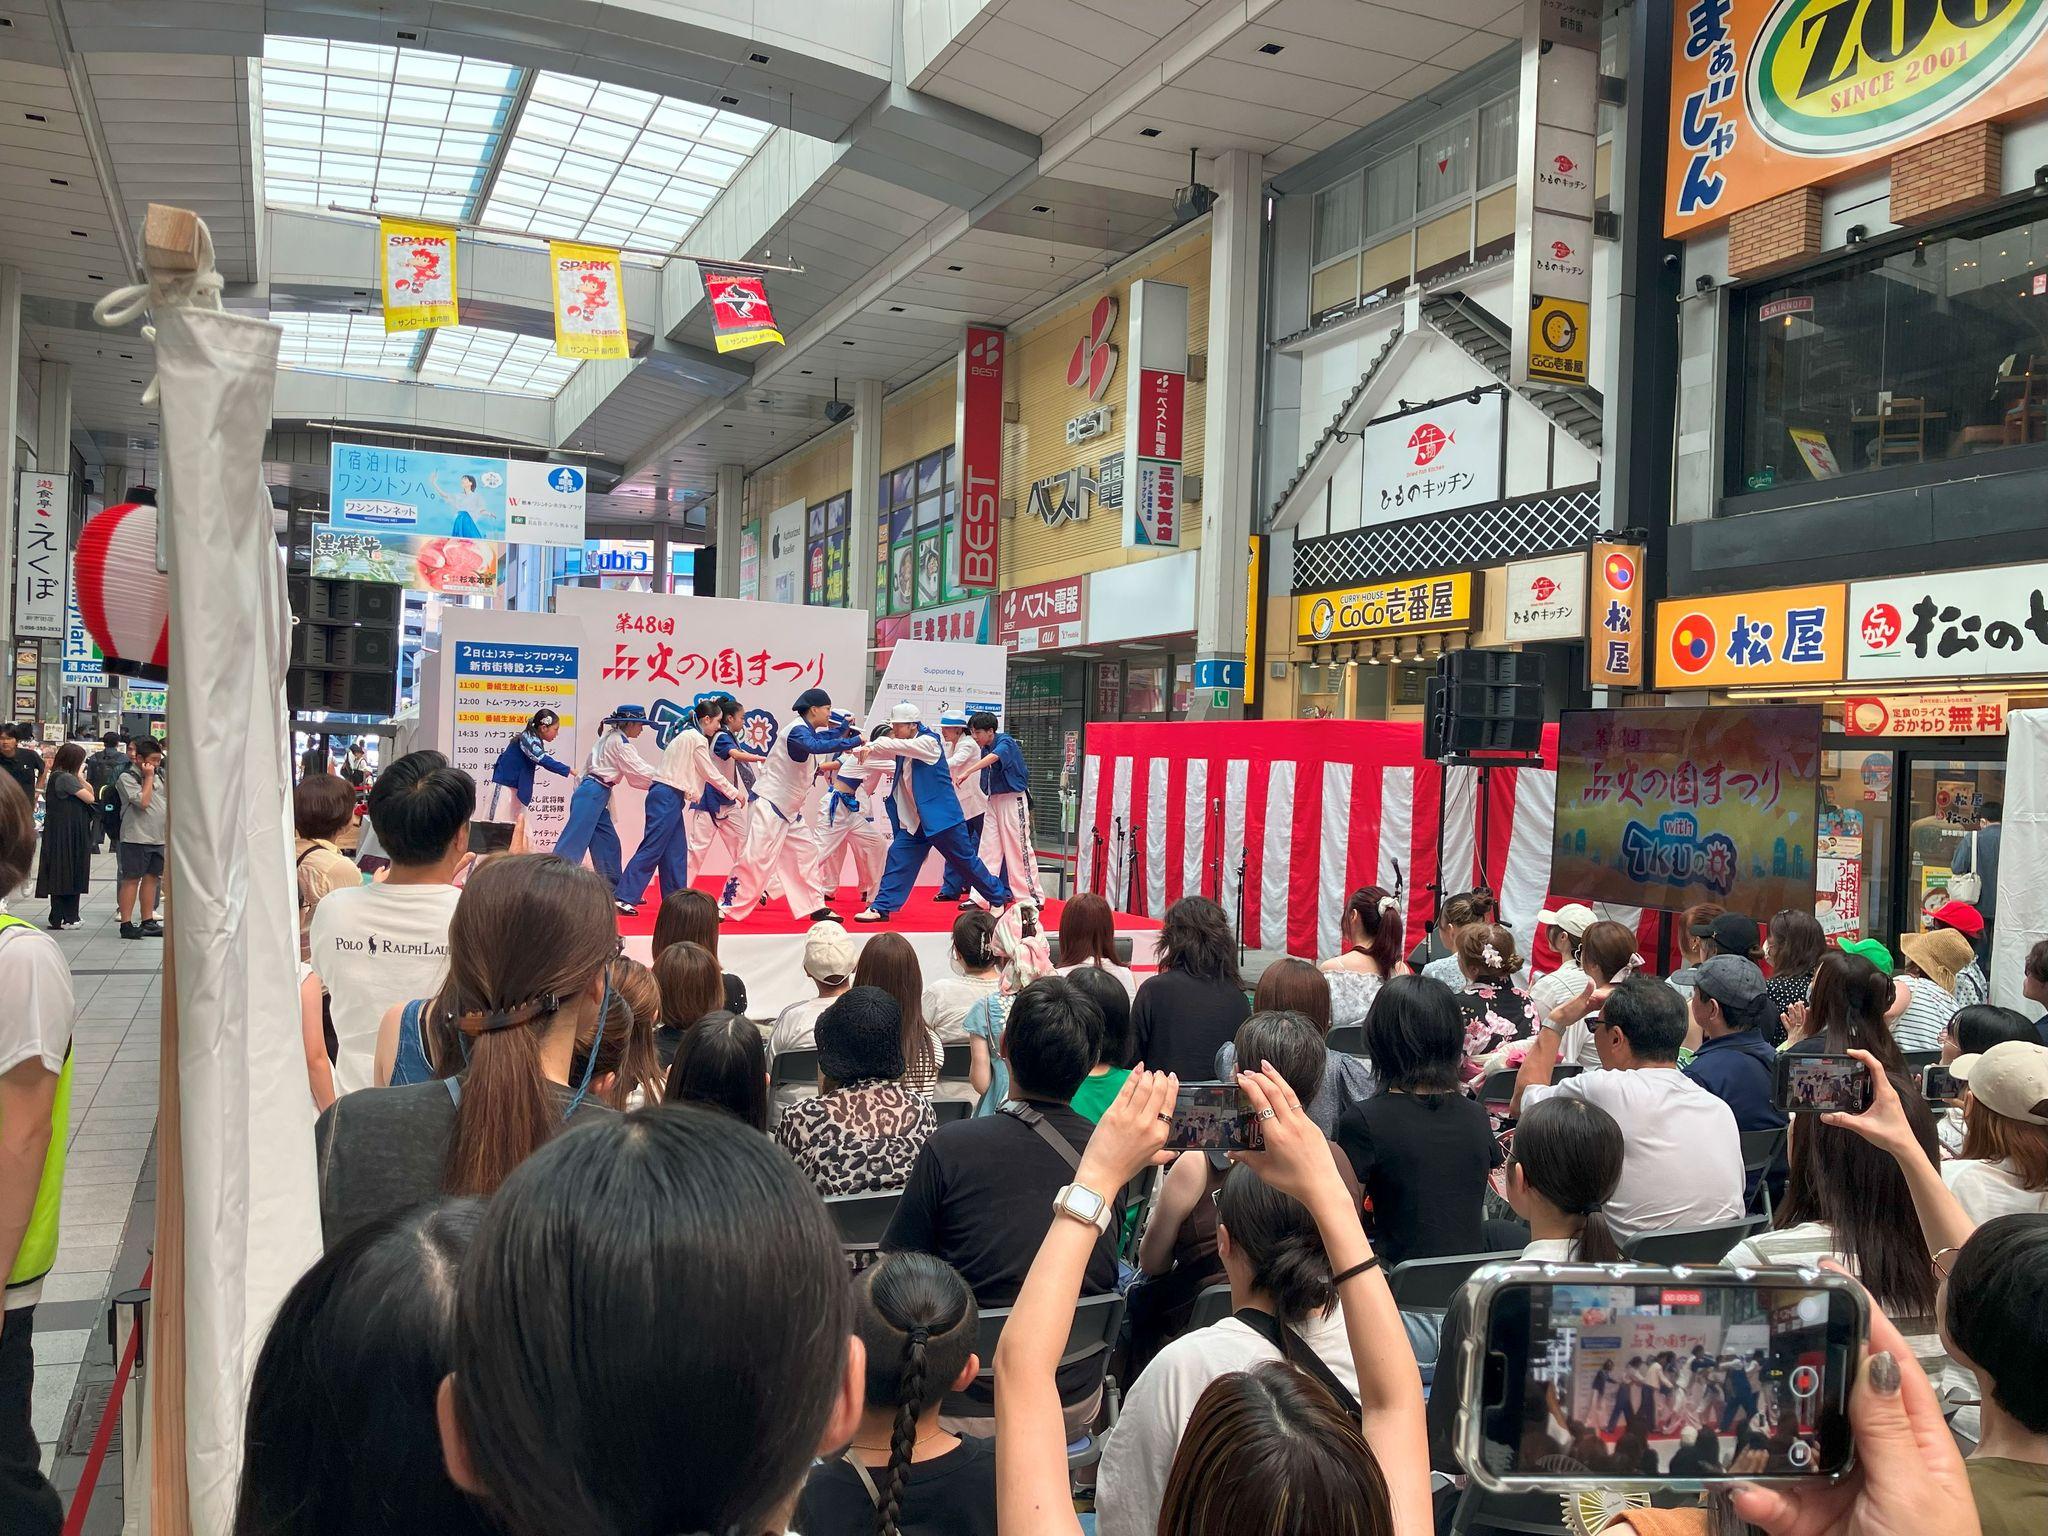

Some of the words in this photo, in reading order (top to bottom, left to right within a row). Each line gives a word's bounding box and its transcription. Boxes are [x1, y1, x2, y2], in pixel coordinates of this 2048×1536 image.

[1830, 71, 1895, 114] SINCE
[1905, 41, 1970, 83] 2001
[1539, 173, 1587, 190] ひものキッチン
[390, 236, 448, 247] SPARK
[559, 260, 612, 271] SPARK
[1536, 260, 1585, 276] ひものキッチン
[971, 366, 999, 377] BEST
[1066, 405, 1114, 444] BEST
[1155, 397, 1167, 457] ベスト電器
[337, 448, 408, 474] 「宿泊」は
[338, 473, 436, 500] ワシントンへ。
[1381, 473, 1475, 510] ひものキッチン
[345, 502, 416, 517] ワシントンネット
[964, 465, 996, 583] BEST
[1021, 586, 1078, 619] ベスト電器
[1340, 595, 1360, 604] CURRY
[1362, 591, 1384, 600] HOUSE
[1340, 581, 1453, 628] CoCo壱番屋
[615, 612, 675, 636] 第48回
[1513, 606, 1573, 624] ひものキッチン
[1042, 631, 1055, 643] au
[1604, 600, 1632, 674] 松屋
[1726, 607, 1826, 667] 松屋
[470, 660, 565, 675] 新市街特設ステージ
[647, 642, 824, 688] 火の国まつり
[923, 667, 955, 676] Supported
[66, 674, 103, 683] 銀行ATM
[927, 685, 948, 693] Audi
[533, 700, 562, 708] ステージ
[1893, 706, 1945, 718] 定食のライス
[1893, 718, 1945, 732] おかわり
[1948, 704, 2003, 732] 無料
[1617, 758, 1780, 810] 火の国まつり
[1955, 793, 1983, 806] 松屋
[537, 814, 564, 822] ステージ
[1664, 817, 1694, 835] with
[335, 937, 363, 950] POLO
[382, 940, 422, 955] RALPH
